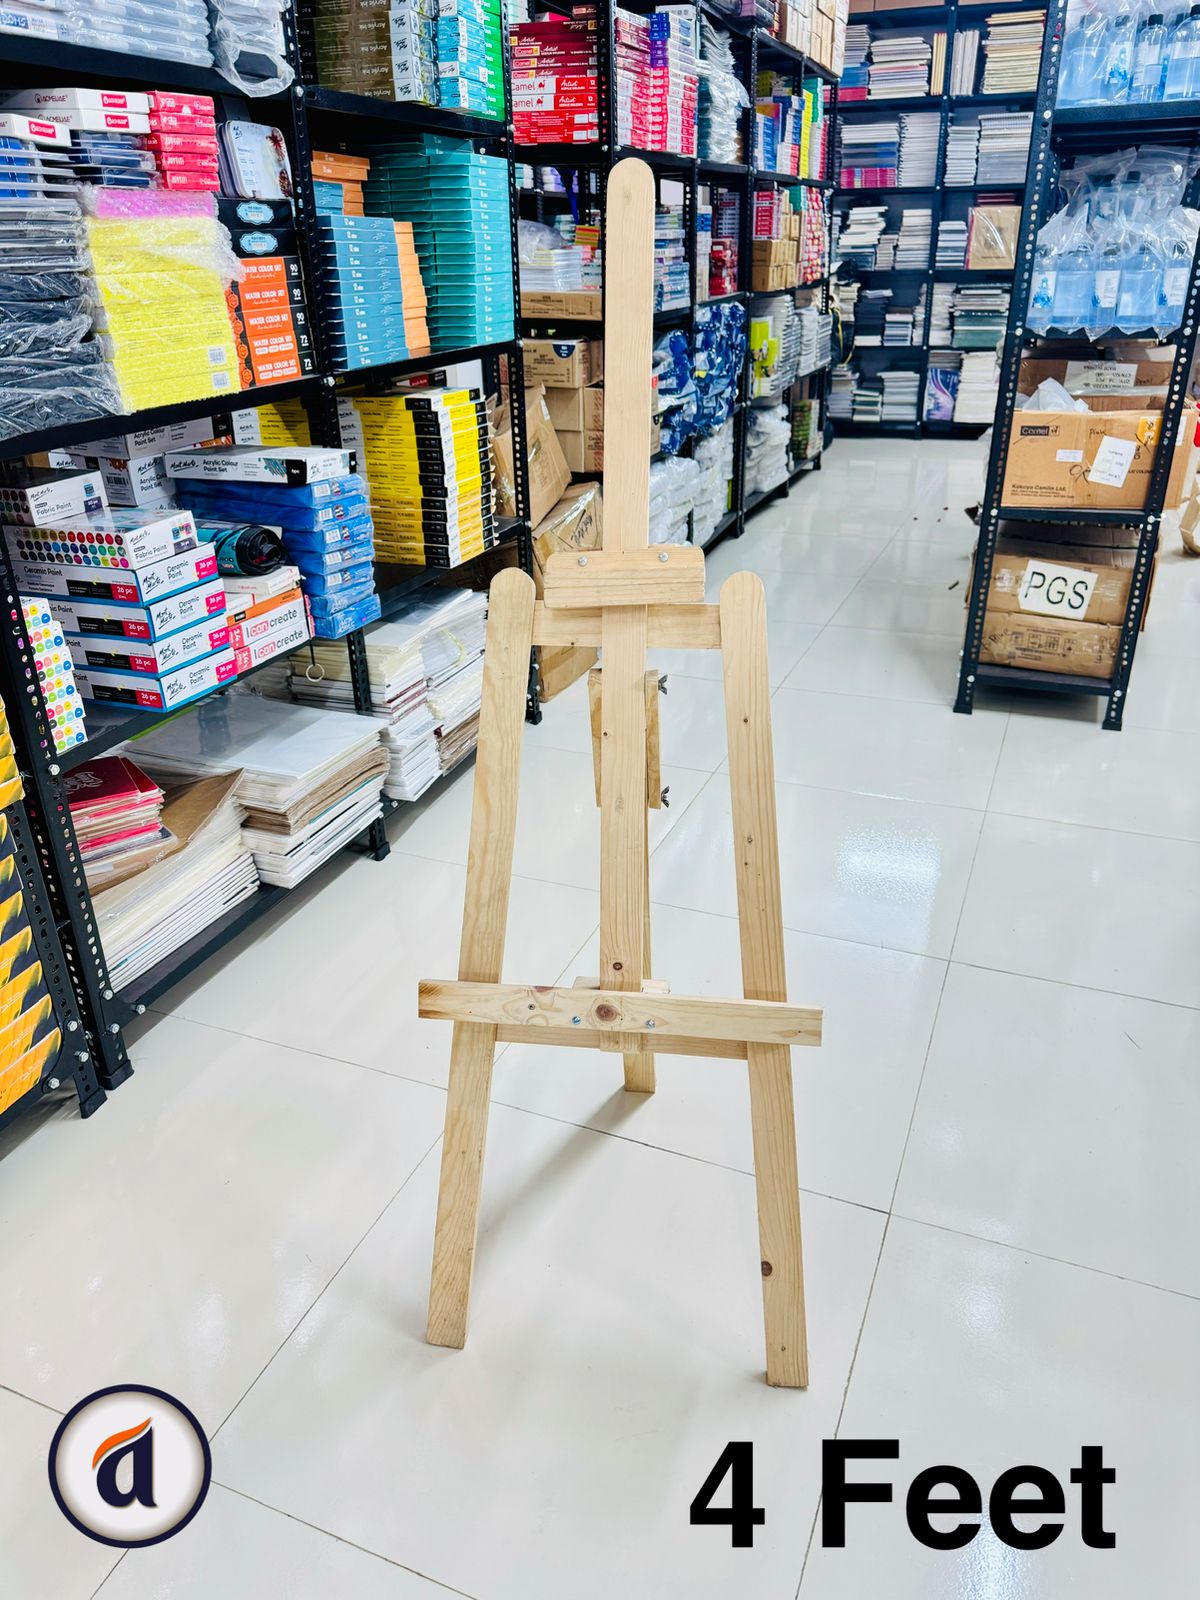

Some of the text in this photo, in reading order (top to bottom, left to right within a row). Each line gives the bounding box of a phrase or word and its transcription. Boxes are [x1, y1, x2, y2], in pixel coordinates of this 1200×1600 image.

[510, 82, 536, 91] Camel
[258, 264, 273, 272] COLOR
[289, 263, 299, 273] 90
[244, 291, 261, 299] WATER
[261, 290, 277, 298] COLOR
[292, 288, 302, 297] 90
[249, 316, 265, 325] WATER
[265, 315, 280, 323] COLOR
[296, 312, 305, 321] 90
[253, 339, 269, 347] WATER
[257, 363, 273, 372] WATER
[273, 361, 289, 369] COLOR
[133, 429, 150, 439] Acrylic
[1021, 427, 1048, 435] Camel
[134, 438, 147, 447] Paint
[203, 459, 221, 467] Acrylic
[140, 475, 156, 485] Acrylic
[141, 483, 153, 492] Paint
[36, 506, 56, 516] Fabric
[135, 545, 167, 560] Fabric Paint
[24, 566, 63, 576] Ceramic Paint
[166, 560, 189, 573] Ceramic
[167, 570, 183, 580] Paint
[1024, 571, 1088, 609] PGS
[178, 596, 200, 609] Ceramic
[58, 605, 73, 613] Paint
[180, 605, 194, 615] Paint
[251, 622, 268, 637] can
[269, 608, 298, 628] create
[66, 639, 82, 647] Paint
[181, 632, 203, 645] Ceramic
[258, 643, 275, 658] can
[276, 629, 303, 649] create
[182, 641, 197, 651] Paint
[188, 665, 210, 679] Ceramic
[189, 675, 204, 685] Paint
